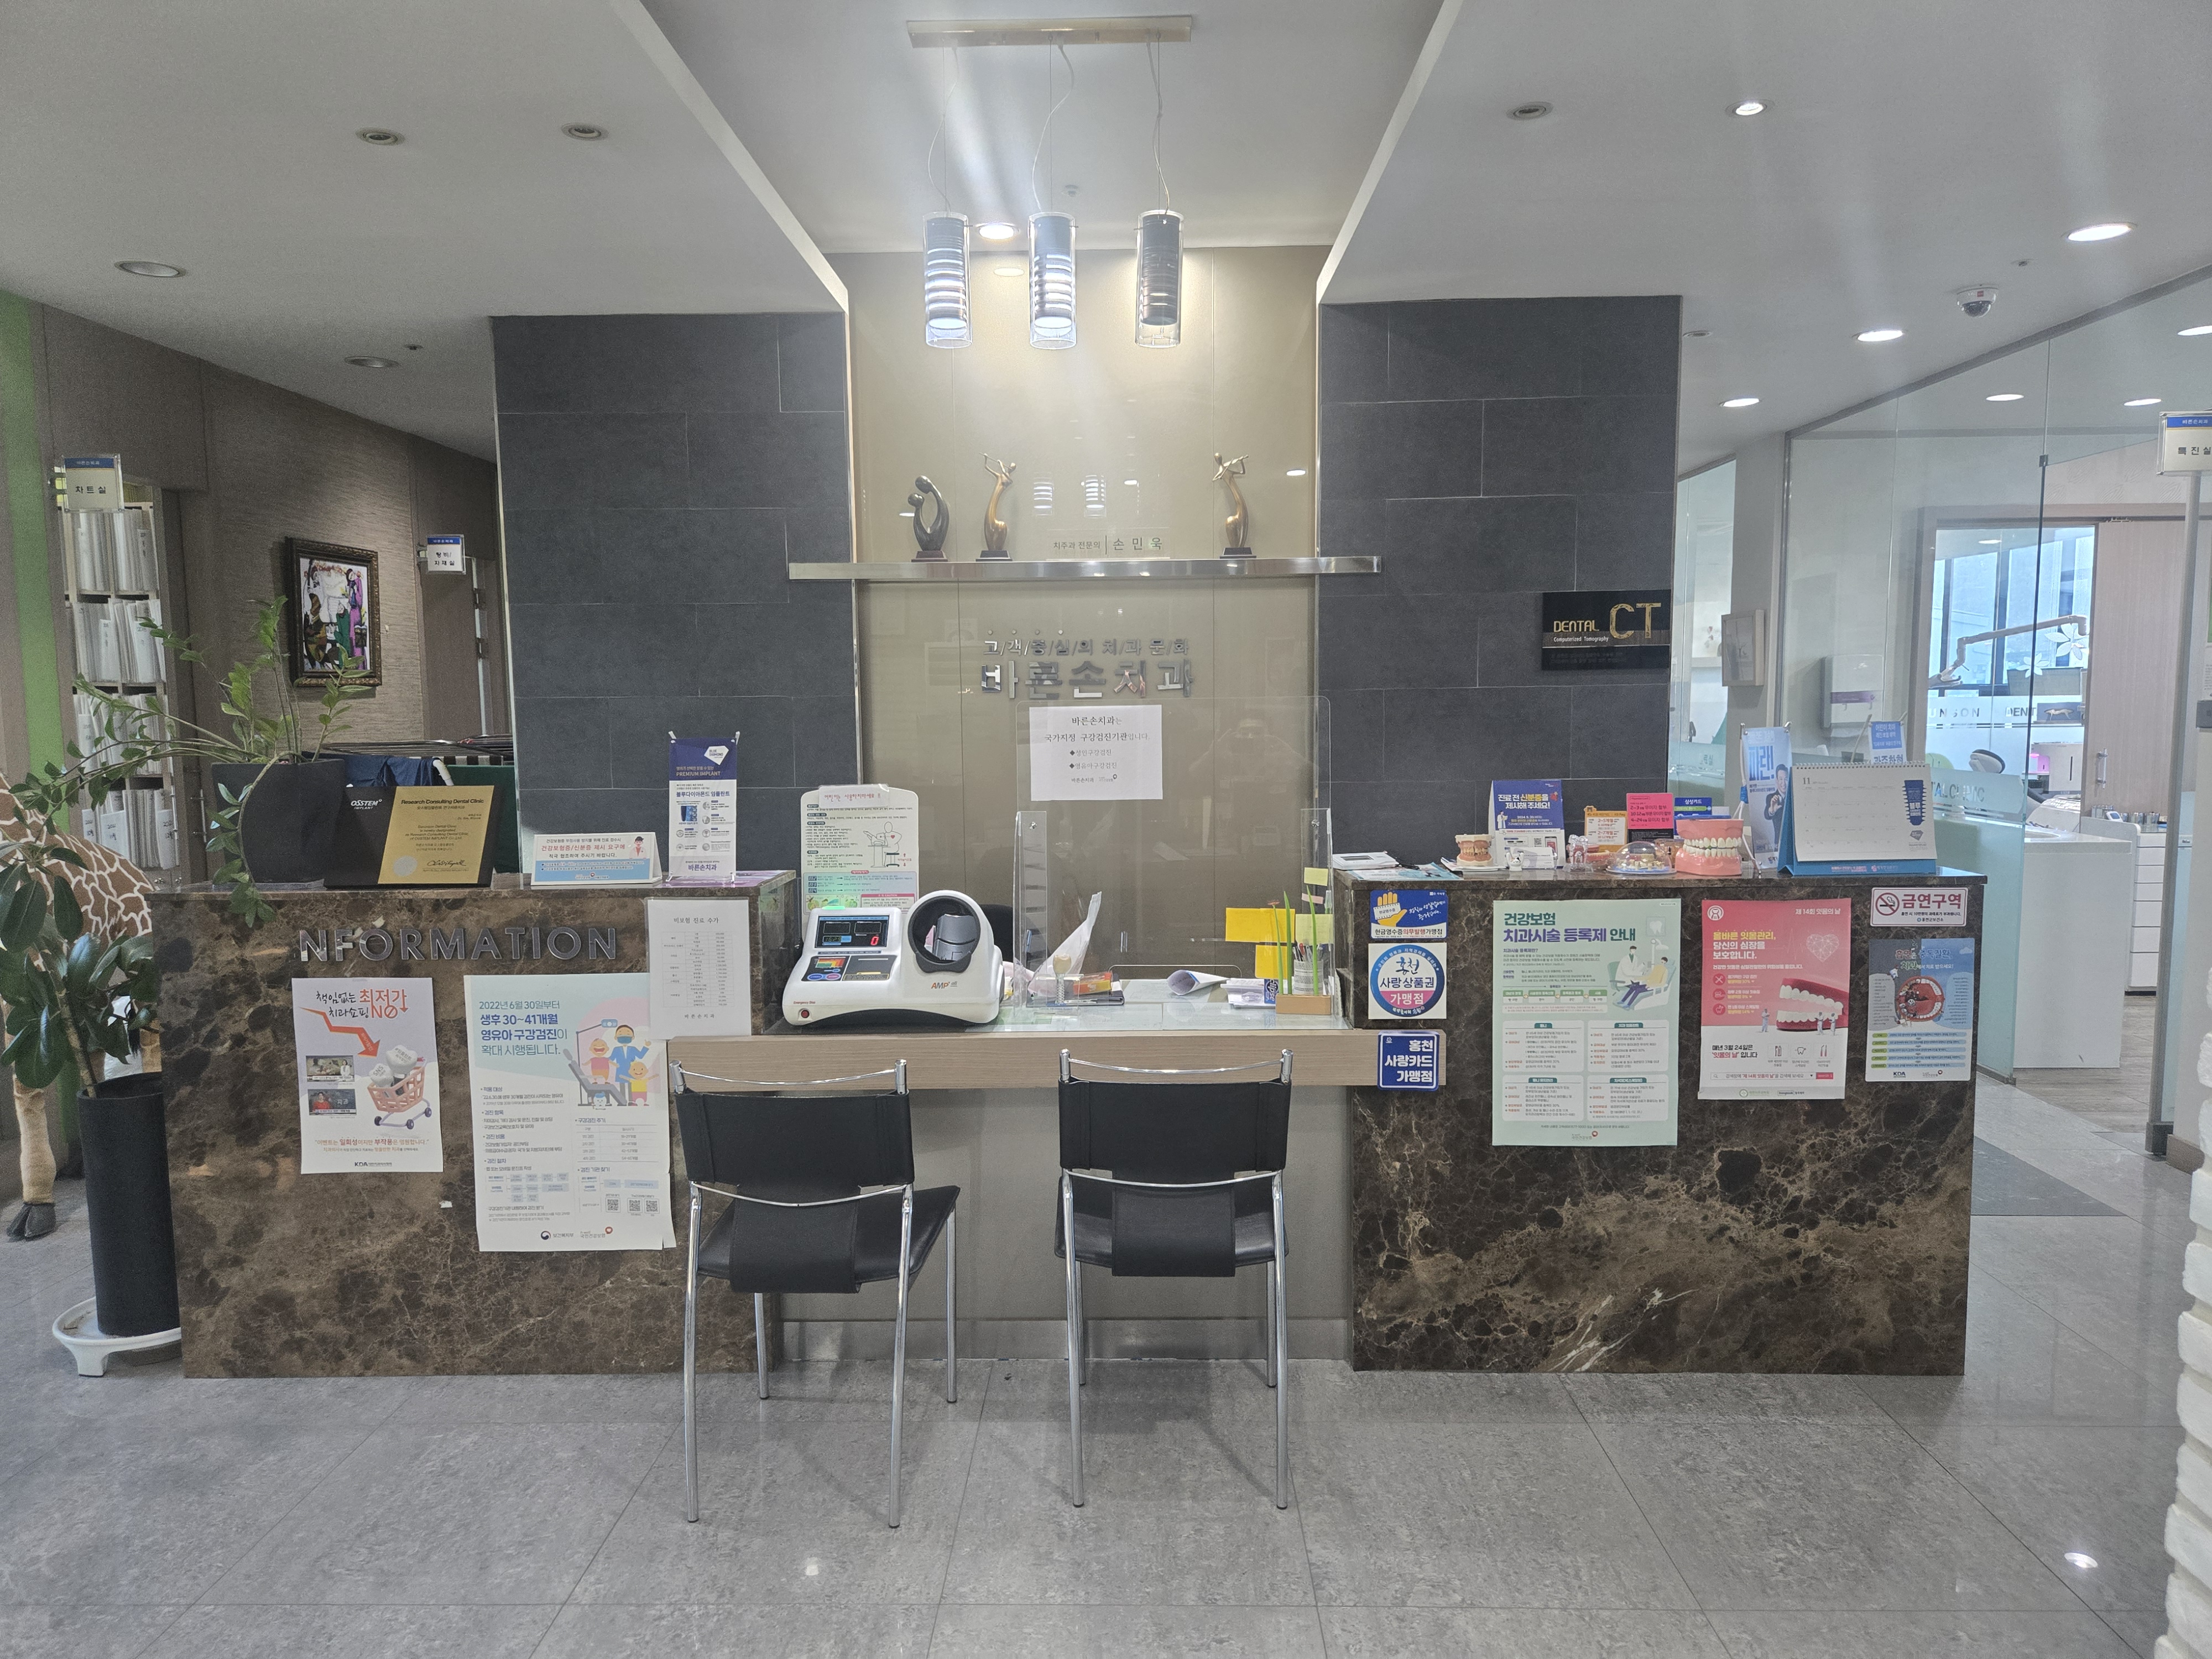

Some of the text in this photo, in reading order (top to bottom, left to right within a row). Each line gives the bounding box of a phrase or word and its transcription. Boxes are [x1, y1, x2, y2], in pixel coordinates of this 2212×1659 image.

[1053, 541, 1076, 550] 치주과
[1078, 541, 1100, 550] 전문의
[1553, 603, 1661, 639] DENTAL CT
[981, 659, 1193, 699] 바른손치과
[1072, 716, 1122, 726] 바른손치과는
[1044, 732, 1150, 742] 국가지정 구강검진기관입니다.
[1749, 745, 1774, 781] 파란!
[1902, 894, 1961, 909] 금연구역
[1504, 912, 1556, 926] 건강보험
[1503, 928, 1636, 943] 치과시술 등록제 안내
[1713, 931, 1776, 940] 올바른 잇몸관리,
[1713, 941, 1765, 950] 당신의 심장을
[1713, 951, 1757, 959] 보호합니다.
[1895, 949, 1917, 959] 흡연은
[1396, 957, 1420, 975] 홍천
[1267, 979, 1277, 1001] clipse
[316, 989, 408, 1005] 책임없는 최저가
[1390, 993, 1423, 1005] 가맹점
[509, 1001, 523, 1009] 6월
[524, 1000, 560, 1009] 30일부터
[329, 1006, 369, 1018] 치과쇼핑
[481, 1014, 559, 1026] 생후 30~41개월
[481, 1029, 567, 1041] 영유아 구강검진이
[481, 1044, 561, 1056] 확대 시행됩니다.
[1409, 1040, 1433, 1052] 홍천
[1385, 1055, 1433, 1067] 사랑카드
[373, 1065, 383, 1076] SNS
[1396, 1070, 1432, 1082] 가맹점
